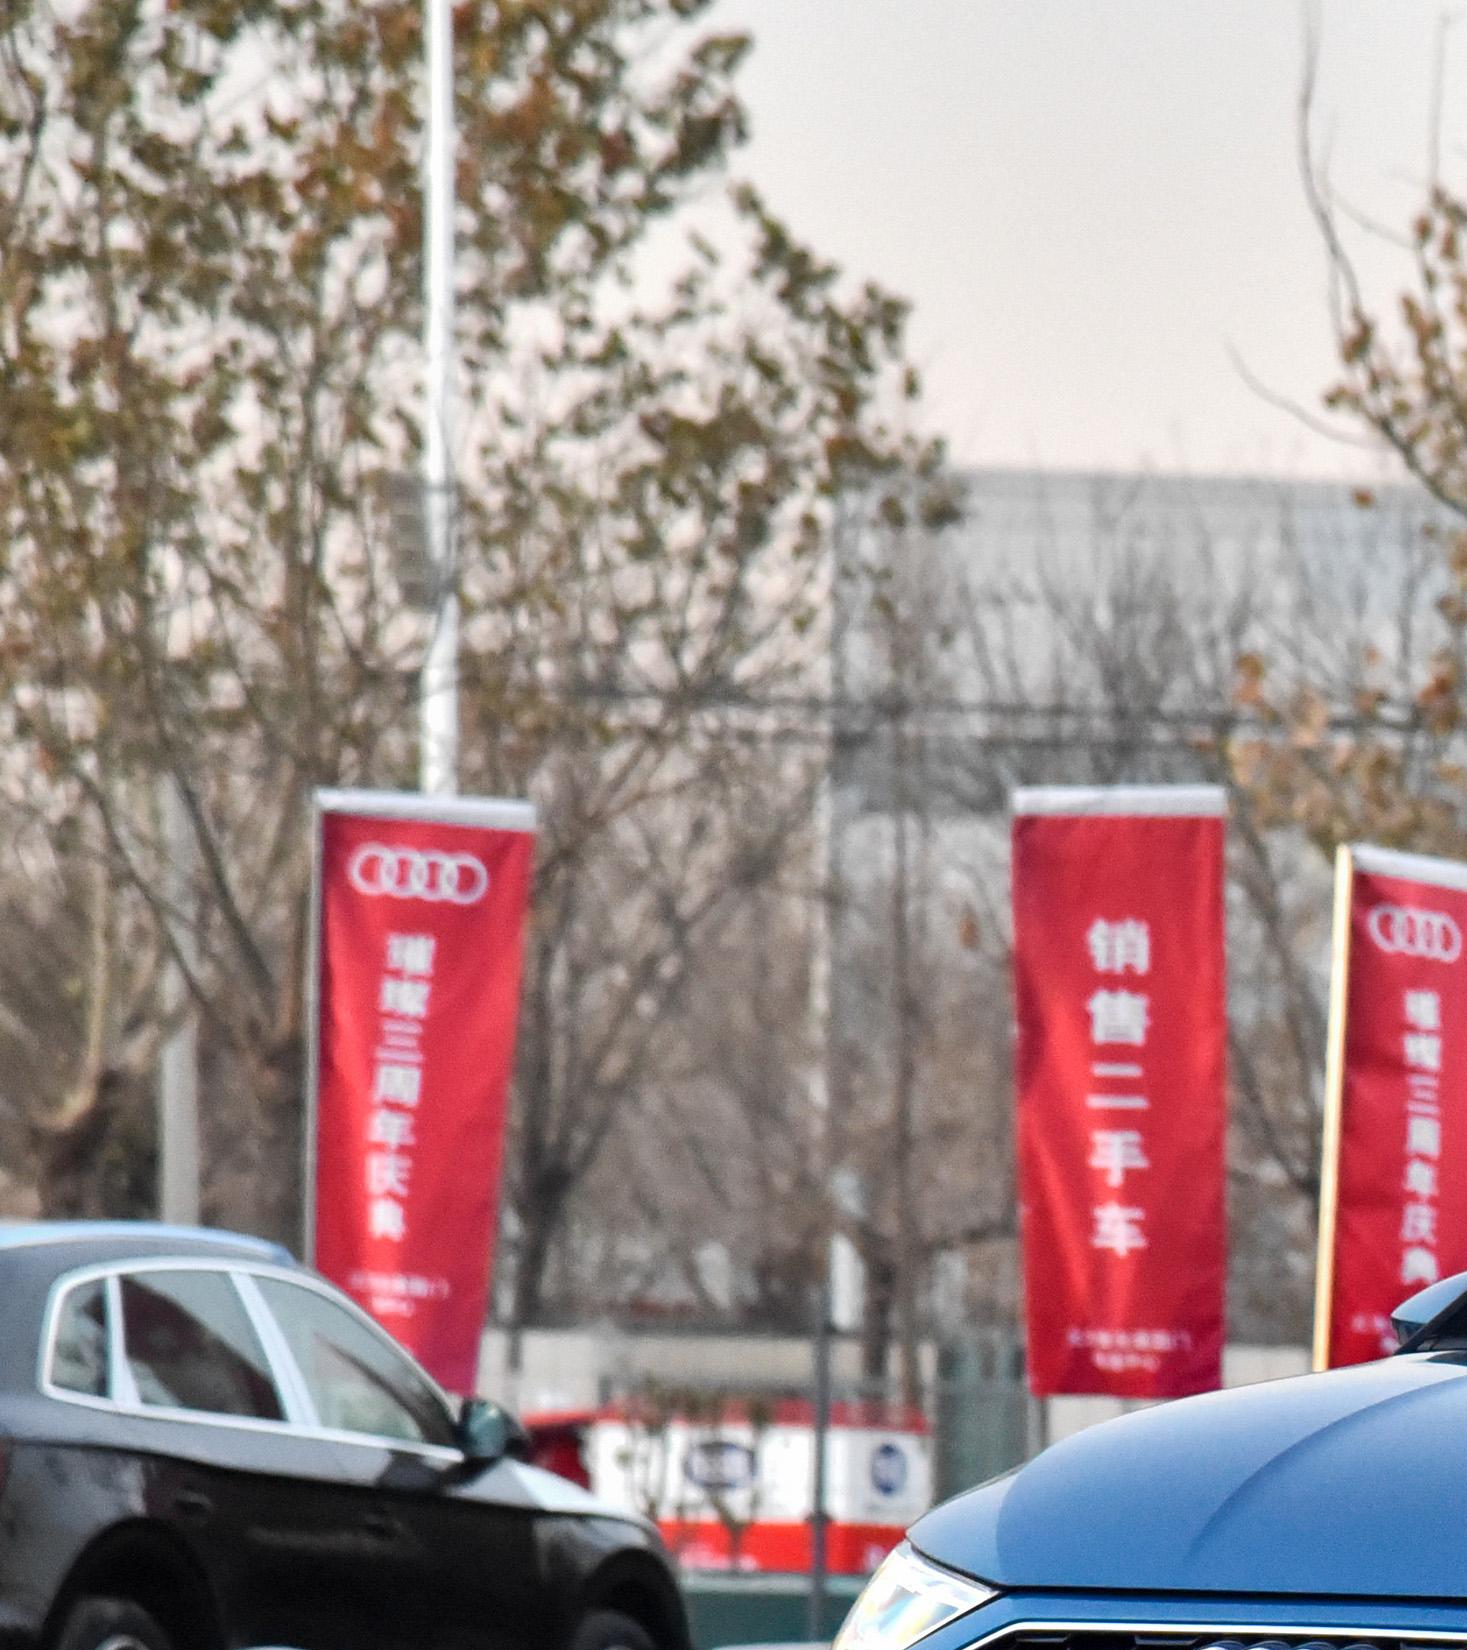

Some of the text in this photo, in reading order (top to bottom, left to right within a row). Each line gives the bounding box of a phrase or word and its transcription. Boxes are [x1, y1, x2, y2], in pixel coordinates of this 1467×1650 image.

[1086, 918, 1150, 1258] 销售二手车
